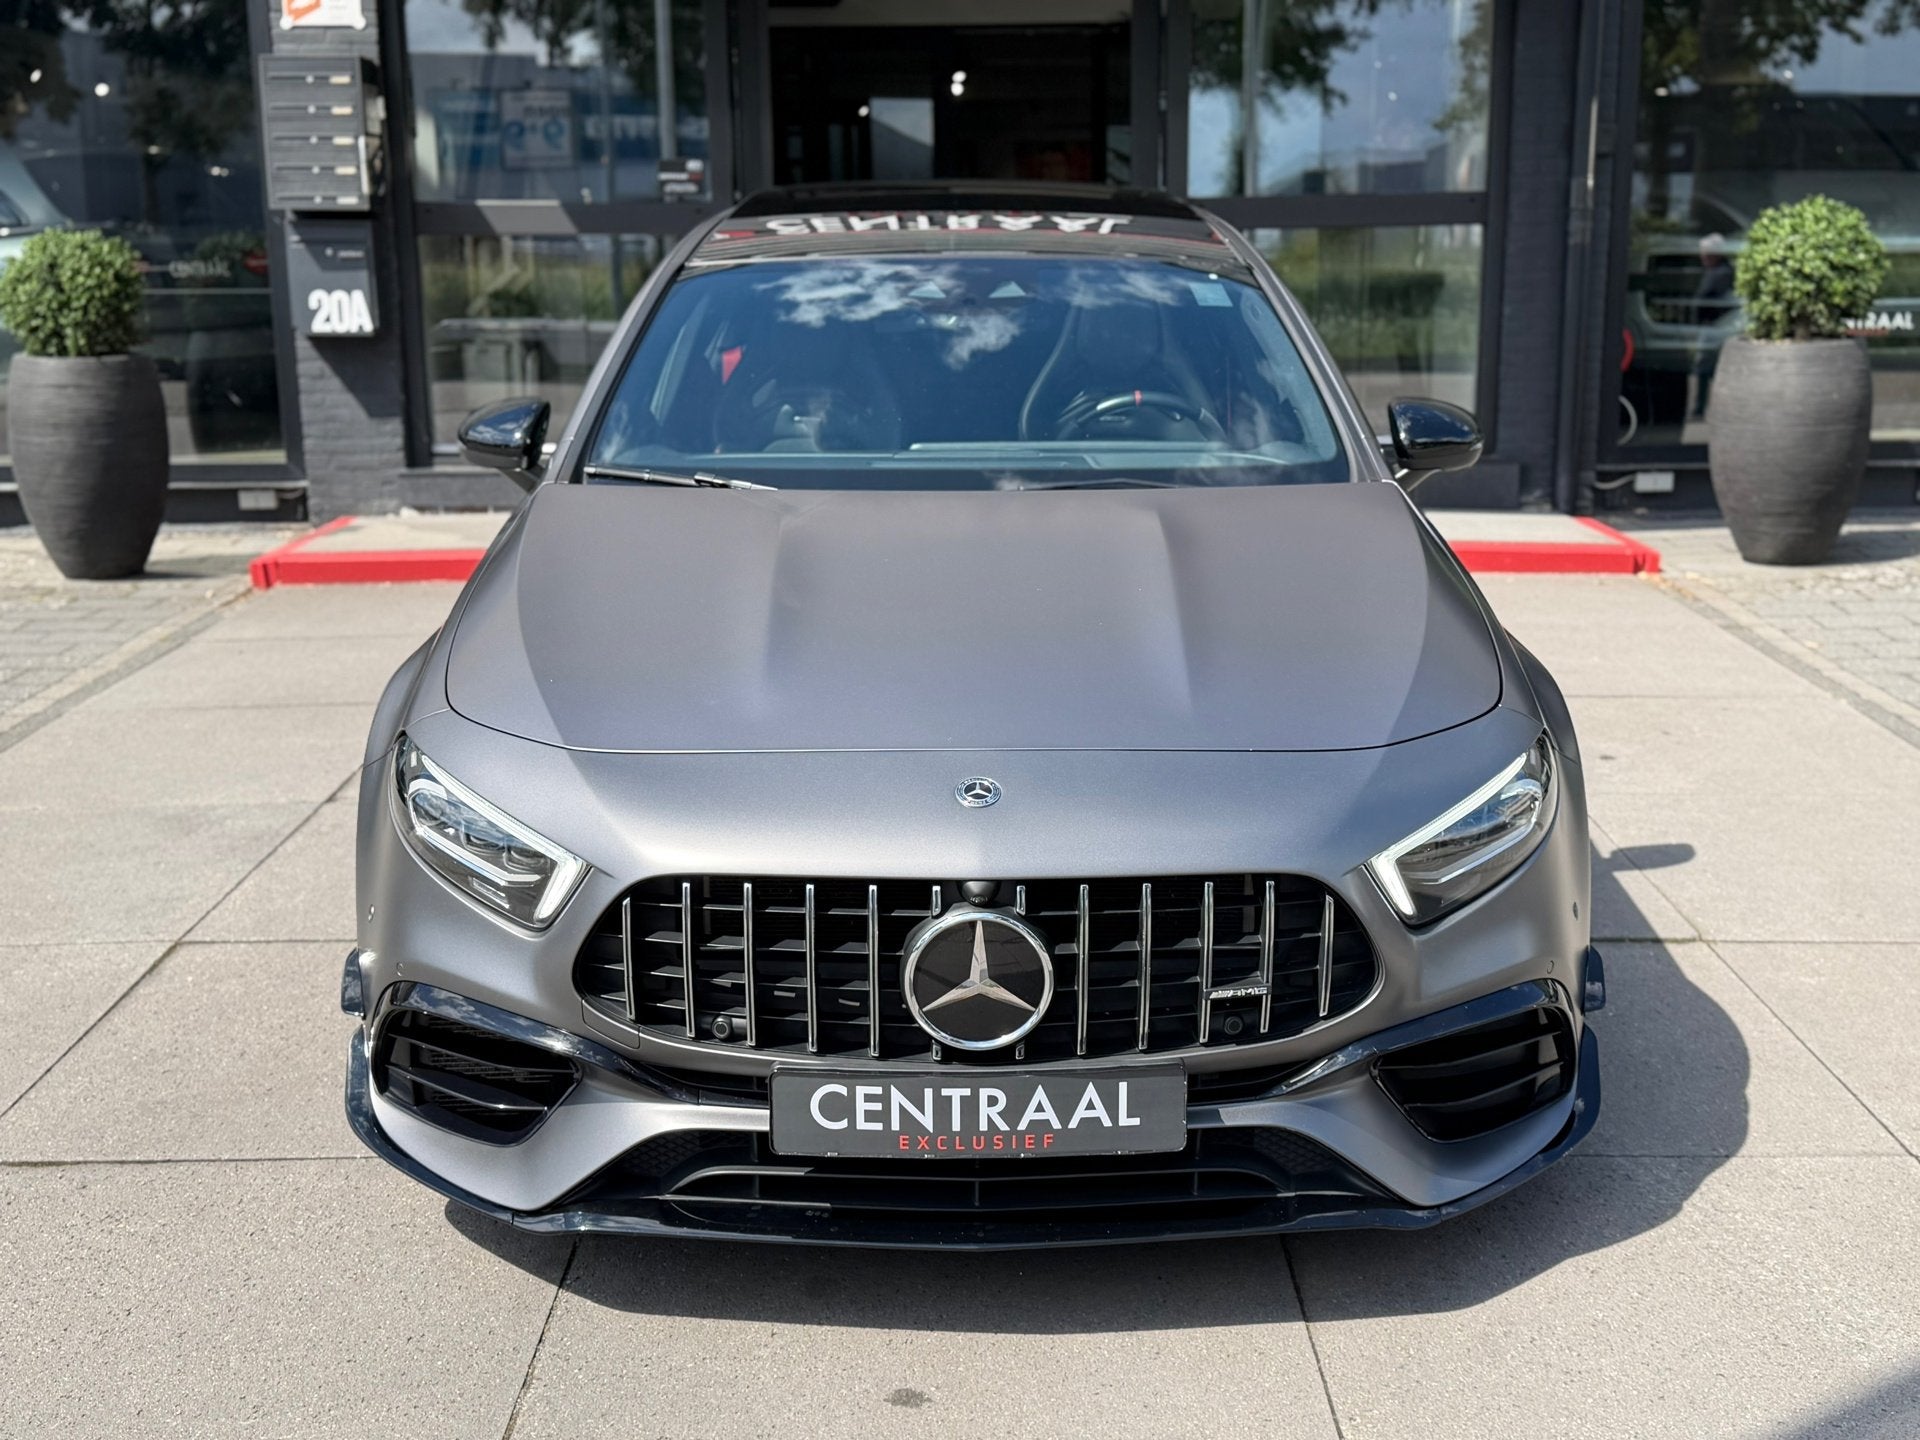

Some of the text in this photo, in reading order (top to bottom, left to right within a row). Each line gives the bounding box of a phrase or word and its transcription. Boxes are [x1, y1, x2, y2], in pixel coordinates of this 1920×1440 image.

[308, 288, 374, 334] 20A
[1228, 986, 1268, 998] AMG
[809, 1081, 1141, 1133] CENTRAAL
[899, 1133, 1056, 1151] EXCLUSIEF
